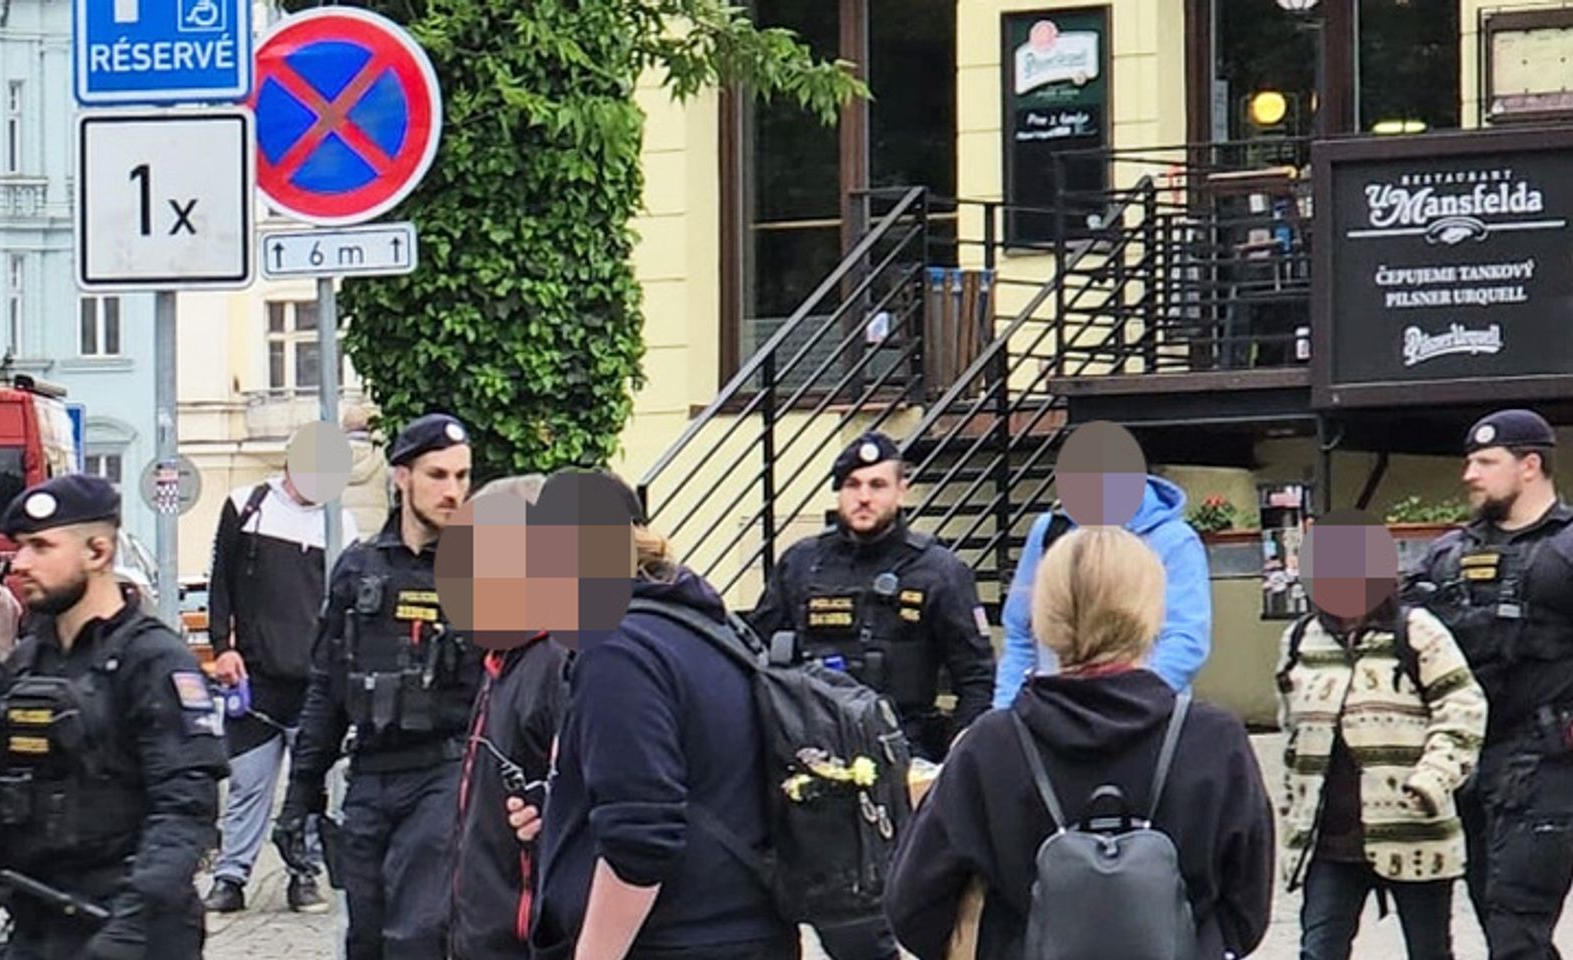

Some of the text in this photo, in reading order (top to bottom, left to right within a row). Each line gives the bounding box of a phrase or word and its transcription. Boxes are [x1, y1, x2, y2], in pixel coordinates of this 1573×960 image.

[90, 32, 235, 73] RÉSERVÉ
[1401, 170, 1513, 186] RESTAURANT
[1369, 182, 1543, 227] Mansfelda
[309, 241, 364, 266] 6 m
[1376, 259, 1534, 285] ČEPUJEME TANKOVÝ
[1386, 286, 1527, 307] PILSNER URQUELL
